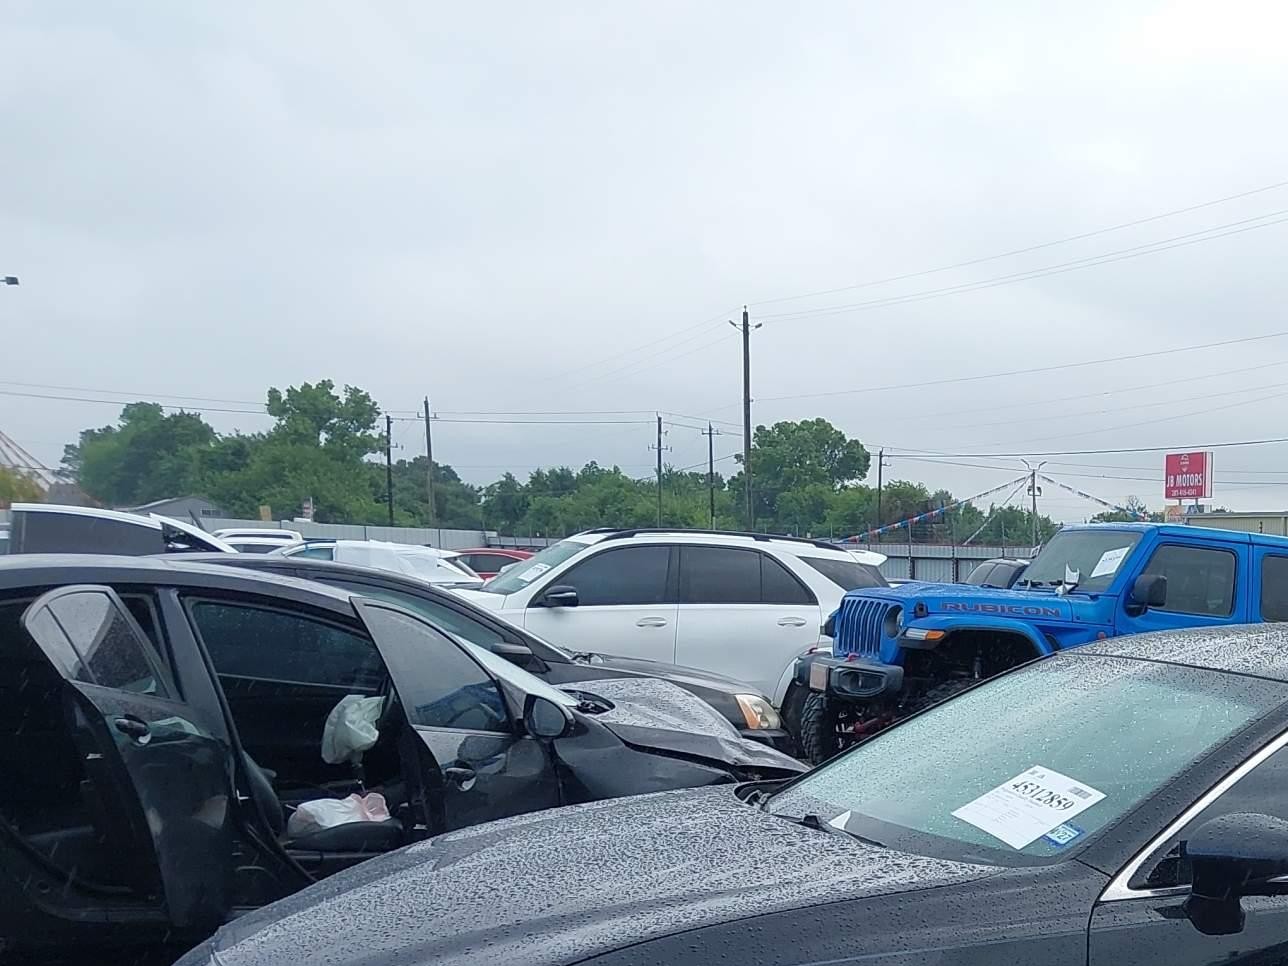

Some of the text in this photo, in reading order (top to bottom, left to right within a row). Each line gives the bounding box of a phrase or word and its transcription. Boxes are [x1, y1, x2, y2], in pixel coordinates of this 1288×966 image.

[1166, 473, 1203, 488] JB MOTORS
[943, 602, 1060, 617] RUBICON
[1011, 780, 1075, 811] 45312859
